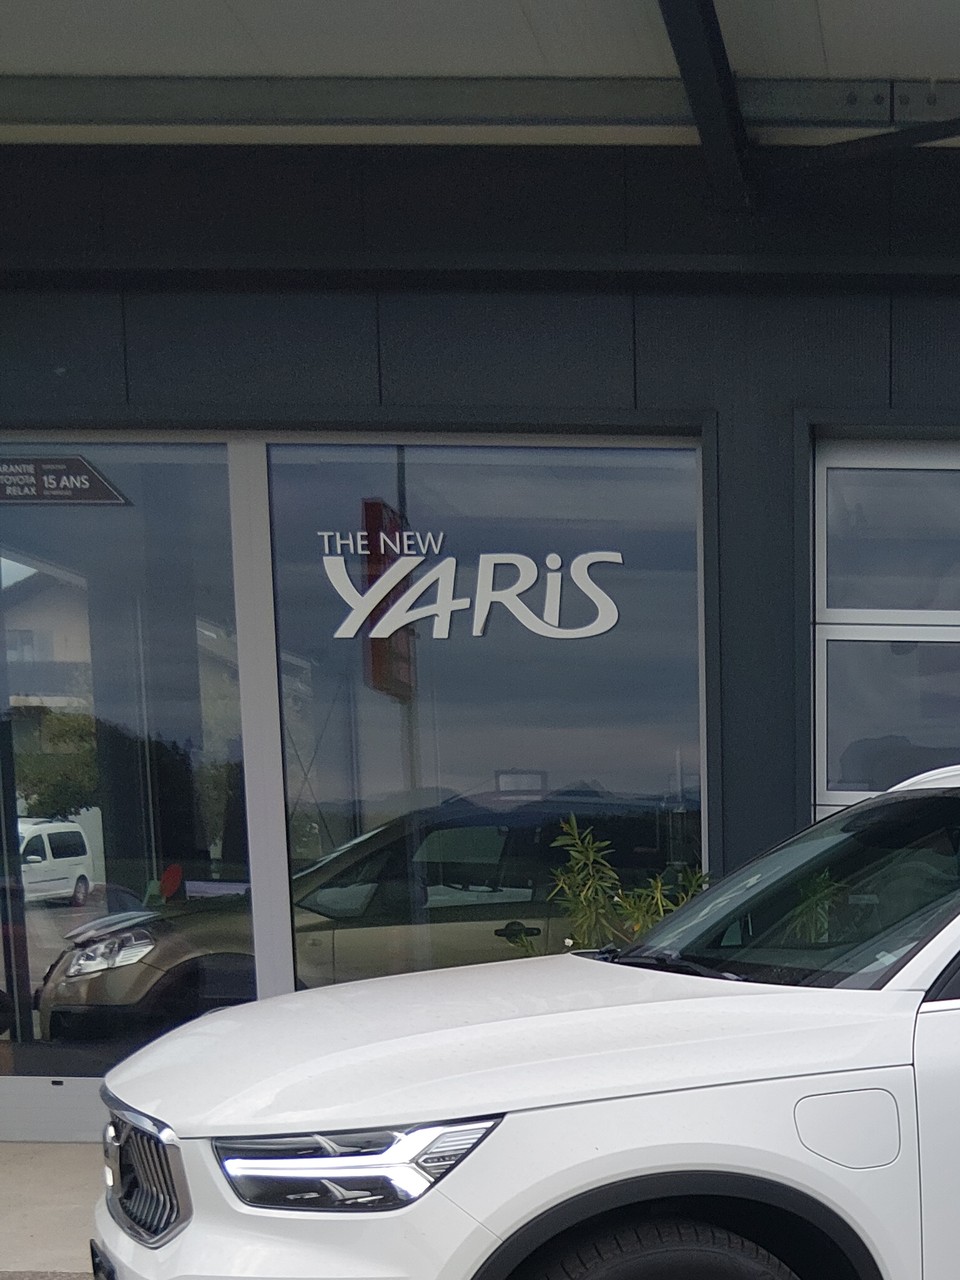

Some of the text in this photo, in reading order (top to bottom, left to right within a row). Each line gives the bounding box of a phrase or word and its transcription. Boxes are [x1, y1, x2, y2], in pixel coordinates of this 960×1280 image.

[43, 475, 90, 489] 15 ANS
[6, 486, 37, 496] RELAX
[317, 531, 445, 555] THE NEW
